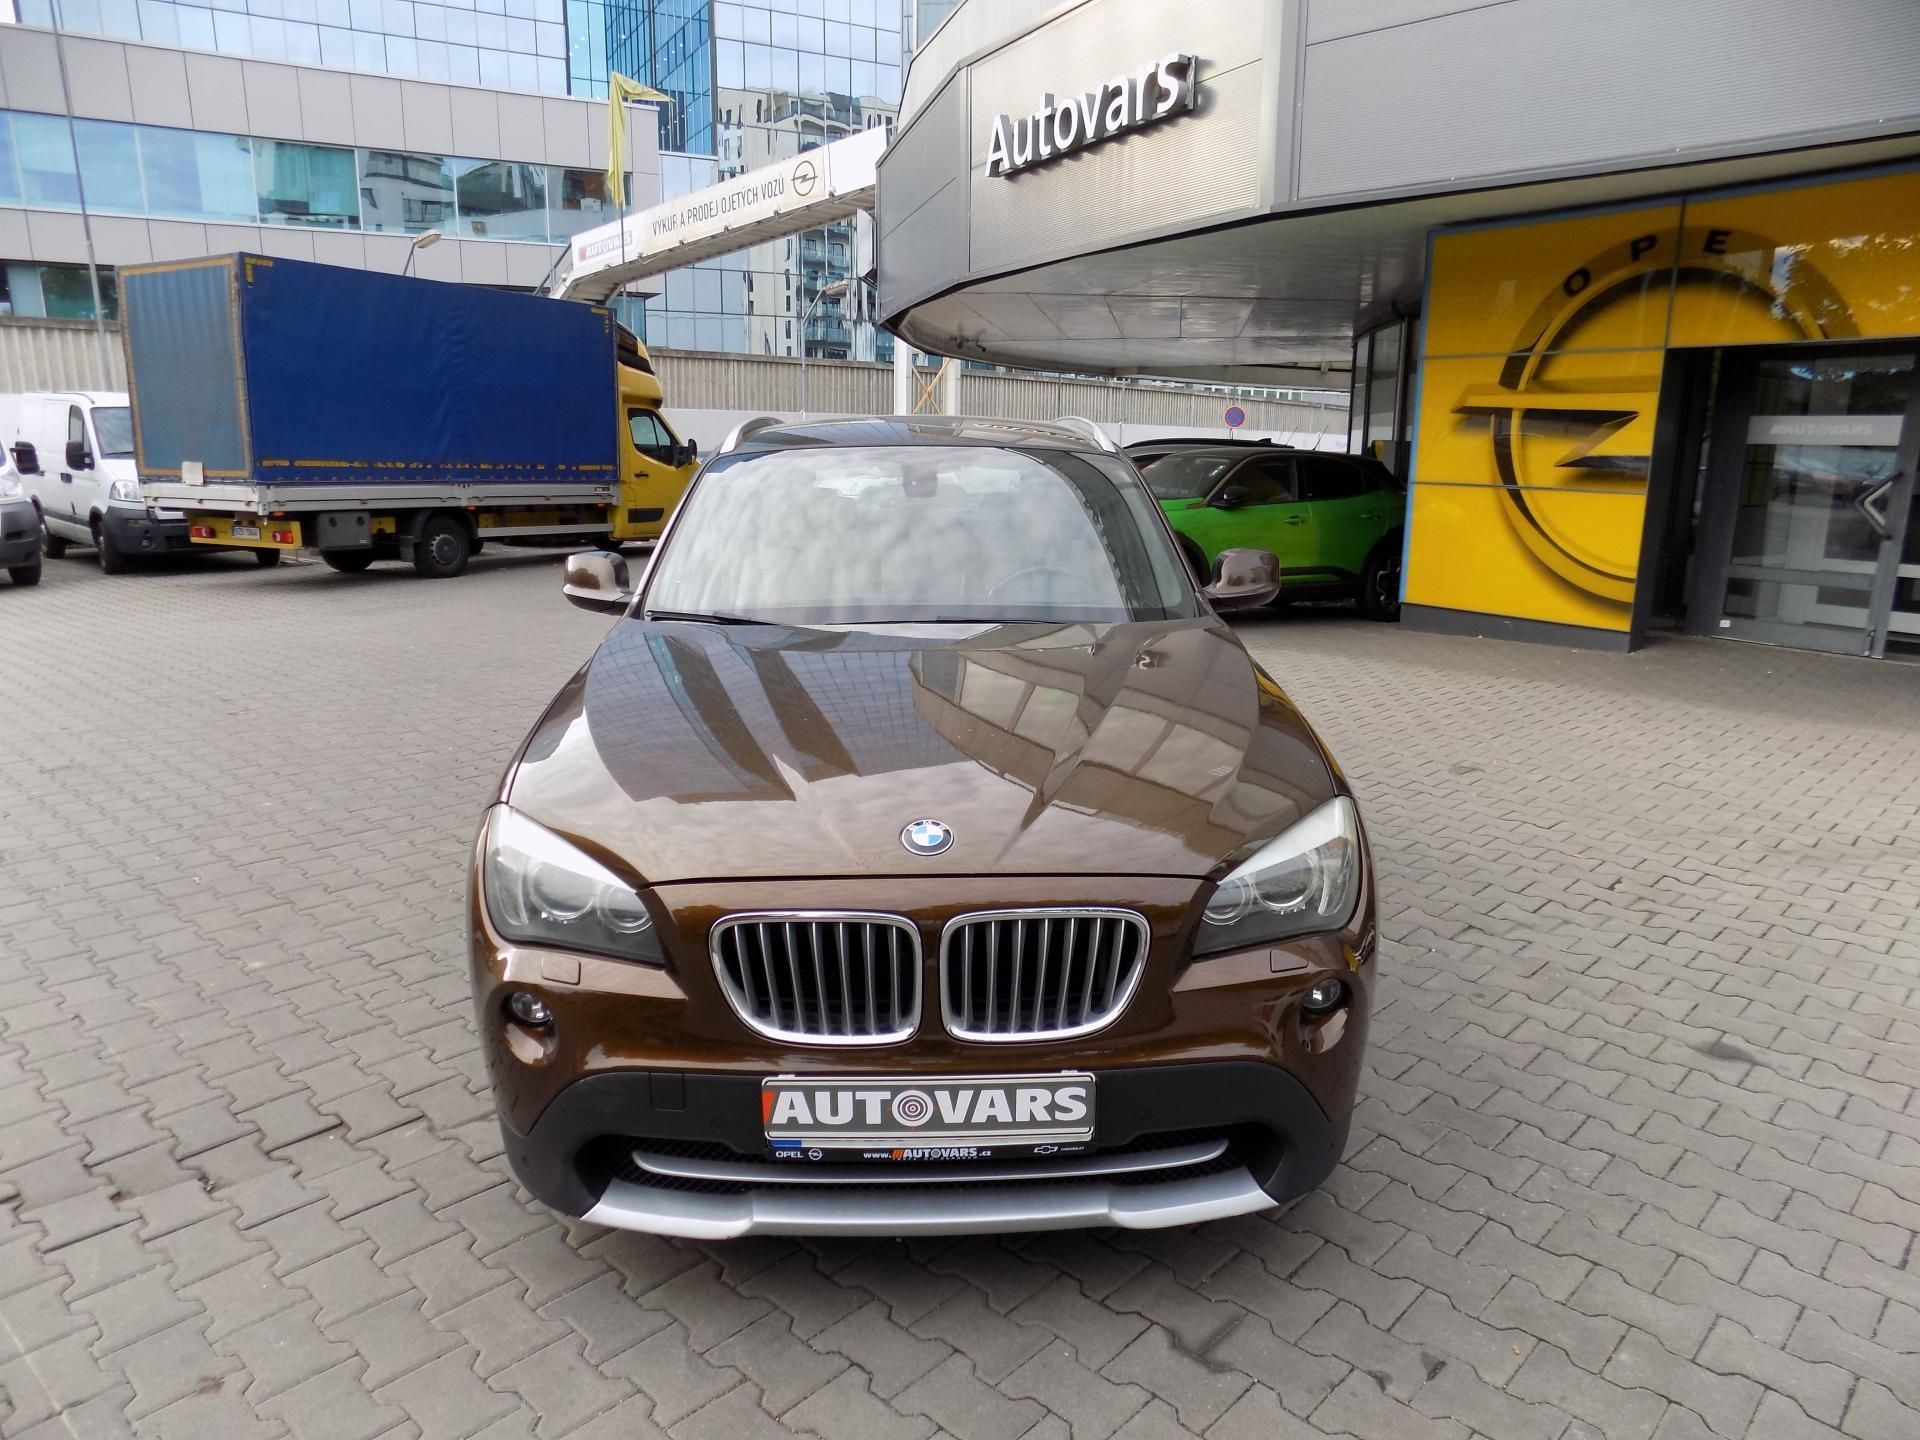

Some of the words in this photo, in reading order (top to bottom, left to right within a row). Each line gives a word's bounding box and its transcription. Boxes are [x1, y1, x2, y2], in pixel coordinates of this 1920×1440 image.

[985, 52, 1190, 177] Autovars
[652, 213, 677, 237] VÝKUP
[680, 215, 686, 228] A
[687, 201, 719, 225] PRODEJ
[721, 187, 759, 214] OJETÝCH
[761, 174, 785, 200] VOZŮ
[1563, 229, 1792, 298] OPE
[771, 1086, 1088, 1127] AUTOVARS
[775, 1150, 804, 1158] OPEL
